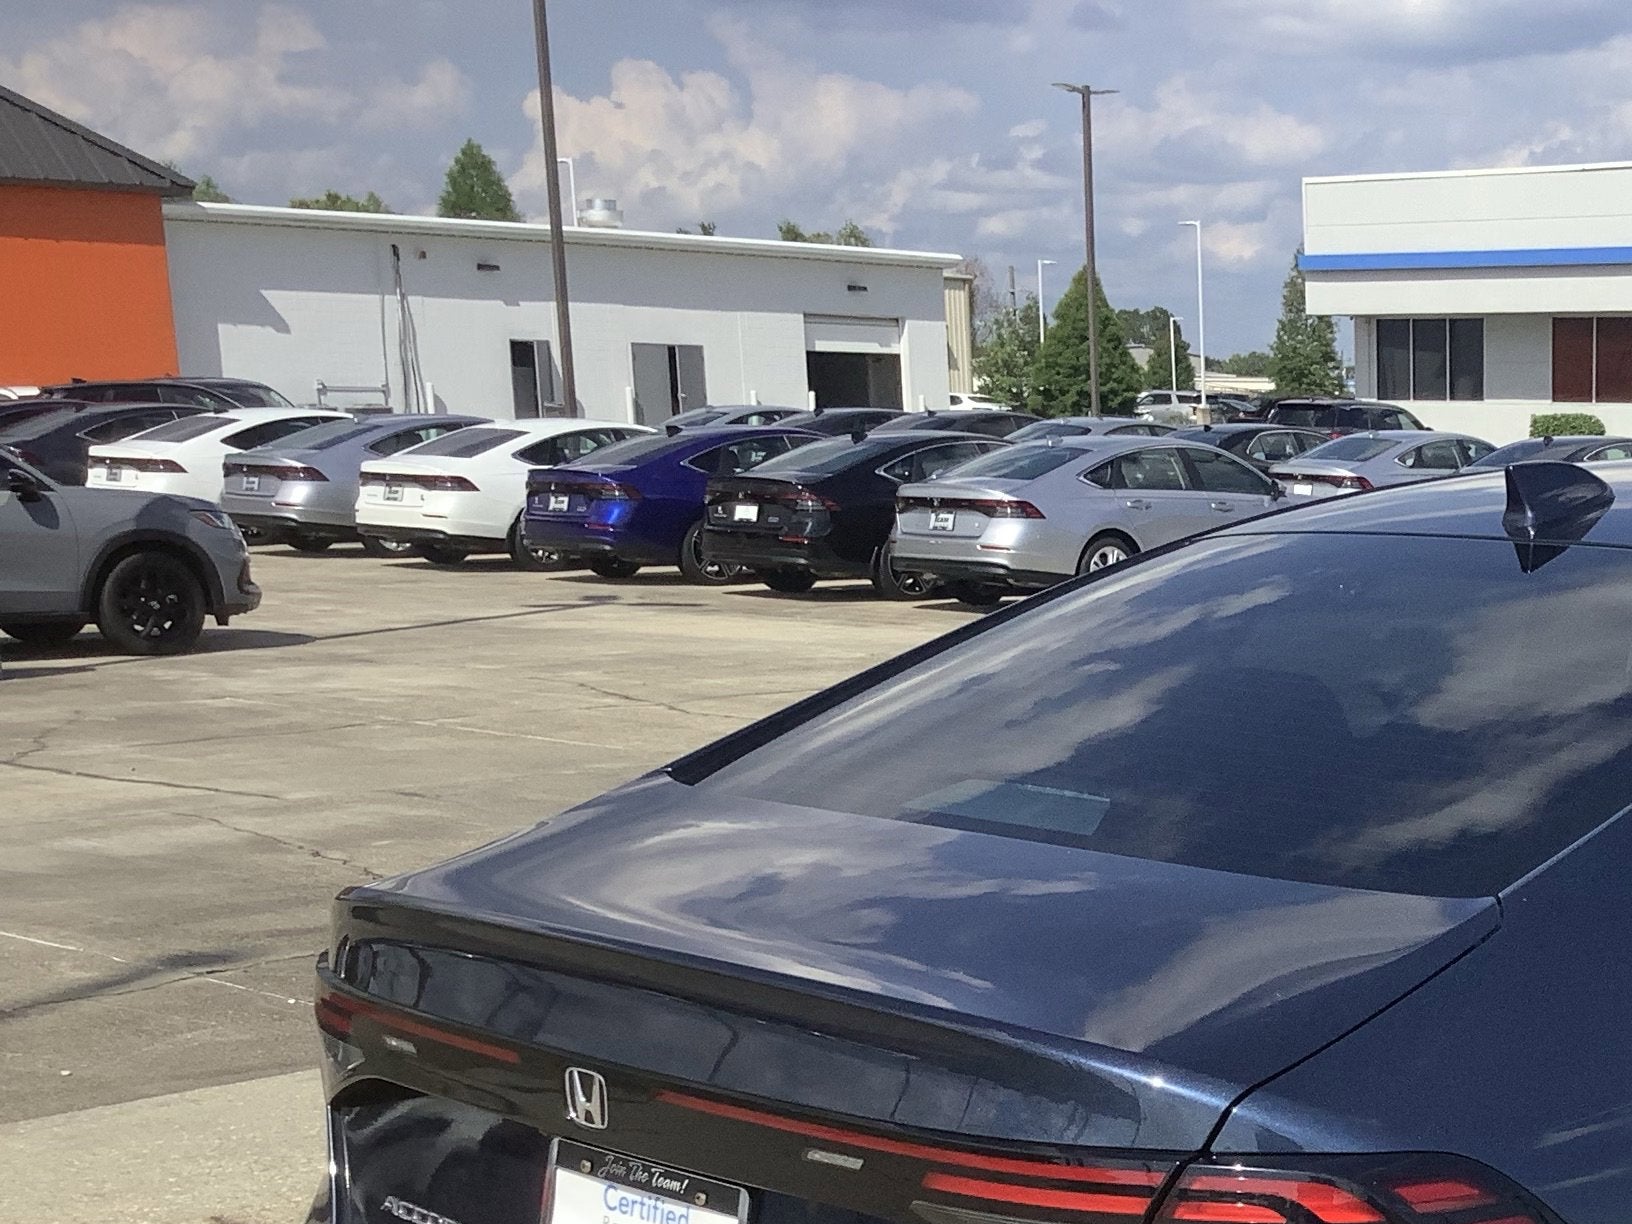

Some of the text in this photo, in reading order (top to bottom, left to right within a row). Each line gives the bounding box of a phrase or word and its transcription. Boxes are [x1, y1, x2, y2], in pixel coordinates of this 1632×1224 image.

[597, 1155, 690, 1195] Join The Team!
